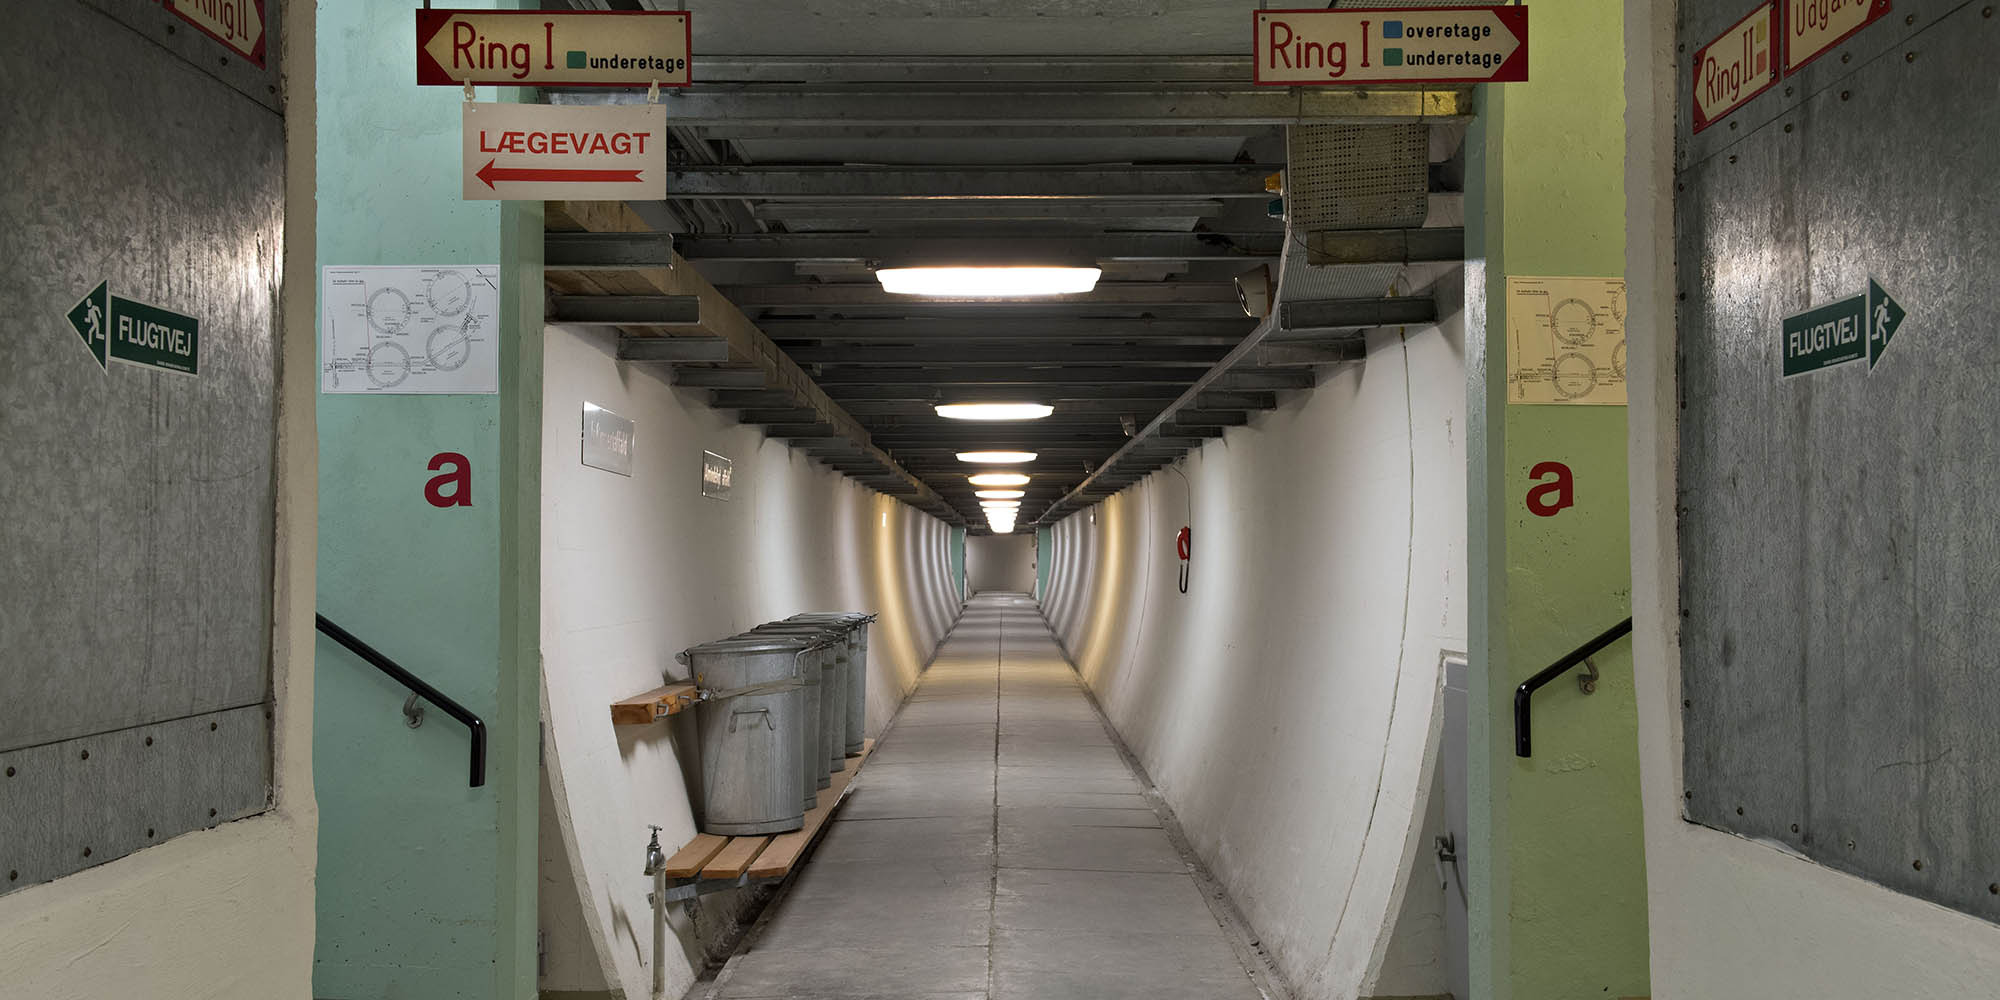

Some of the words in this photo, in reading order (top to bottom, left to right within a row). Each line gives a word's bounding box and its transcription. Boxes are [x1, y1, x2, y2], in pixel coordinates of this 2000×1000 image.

[1406, 24, 1491, 41] overetage
[1795, 0, 1865, 36] Udga
[453, 21, 530, 79] Ring
[544, 22, 554, 70] I
[590, 55, 685, 73] underetage
[1270, 21, 1346, 78] Ring
[1360, 21, 1370, 68] I
[1406, 51, 1502, 69] underetage
[1706, 56, 1740, 109] Ring
[1743, 26, 1754, 85] II
[480, 131, 651, 154] LÆGEVAGT
[119, 314, 192, 357] FLUGTVEJ
[1790, 314, 1859, 358] FLUGTVEJ
[424, 452, 472, 508] a
[1526, 461, 1574, 517] a
